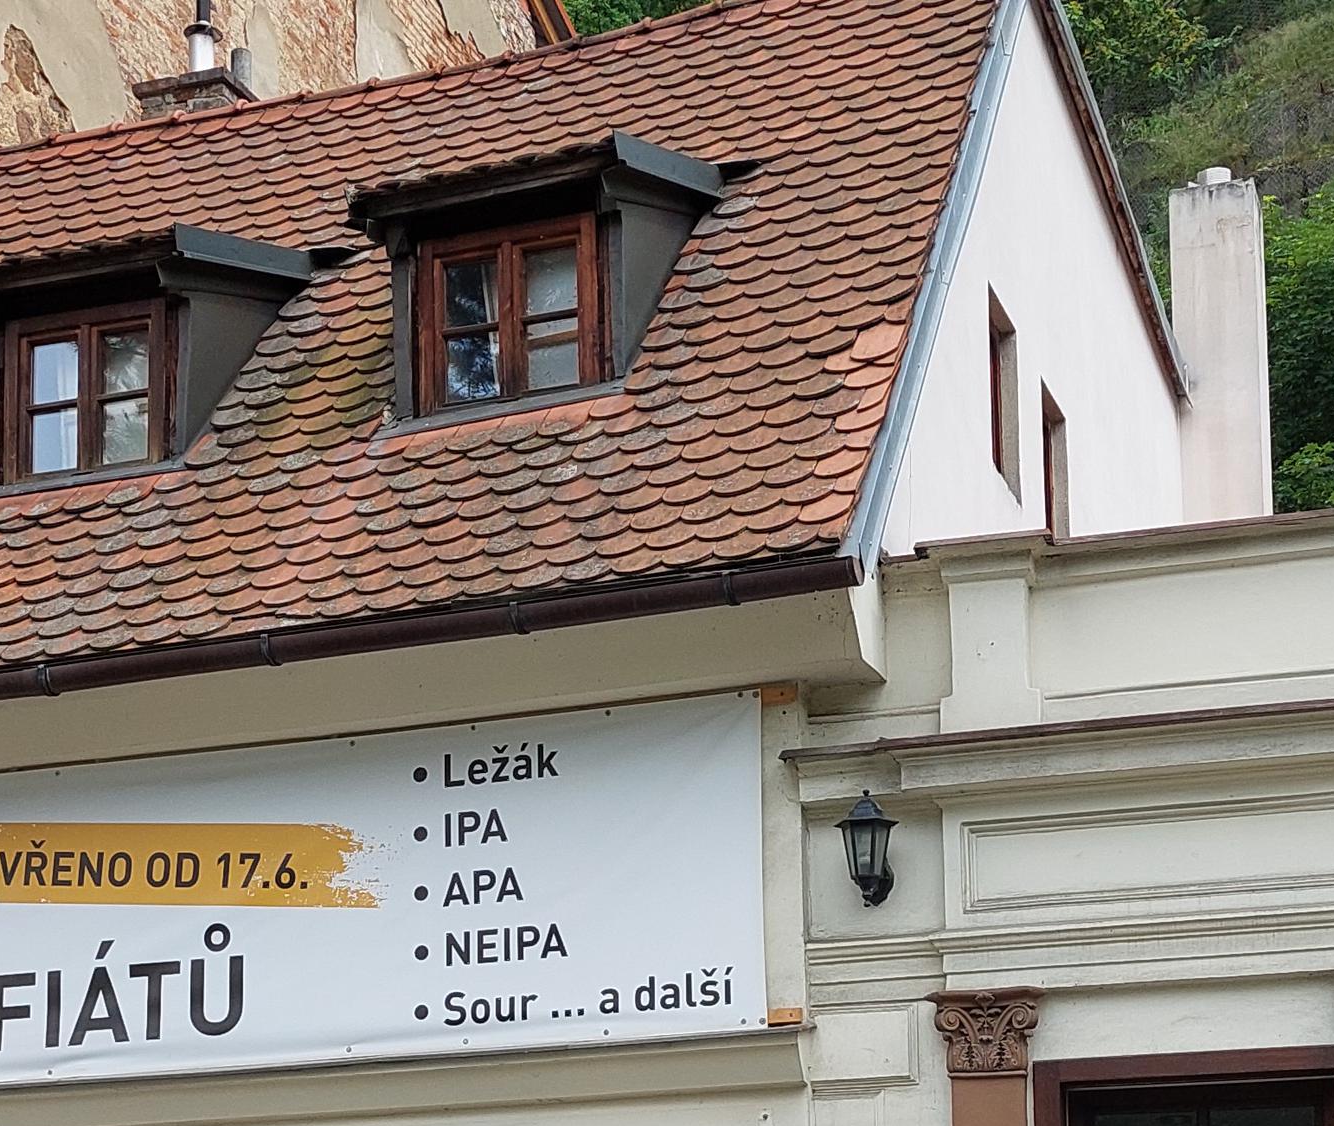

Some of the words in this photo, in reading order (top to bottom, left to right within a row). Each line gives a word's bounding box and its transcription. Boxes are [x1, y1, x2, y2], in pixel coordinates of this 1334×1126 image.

[443, 742, 559, 789] Ležák
[444, 808, 508, 848] IPA
[146, 852, 200, 888] OD
[217, 852, 308, 890] 17.6.
[442, 867, 524, 908] APA
[446, 923, 568, 967] NEIPA
[444, 991, 538, 1026] Sour
[599, 988, 620, 1015] a
[634, 966, 733, 1012] další
